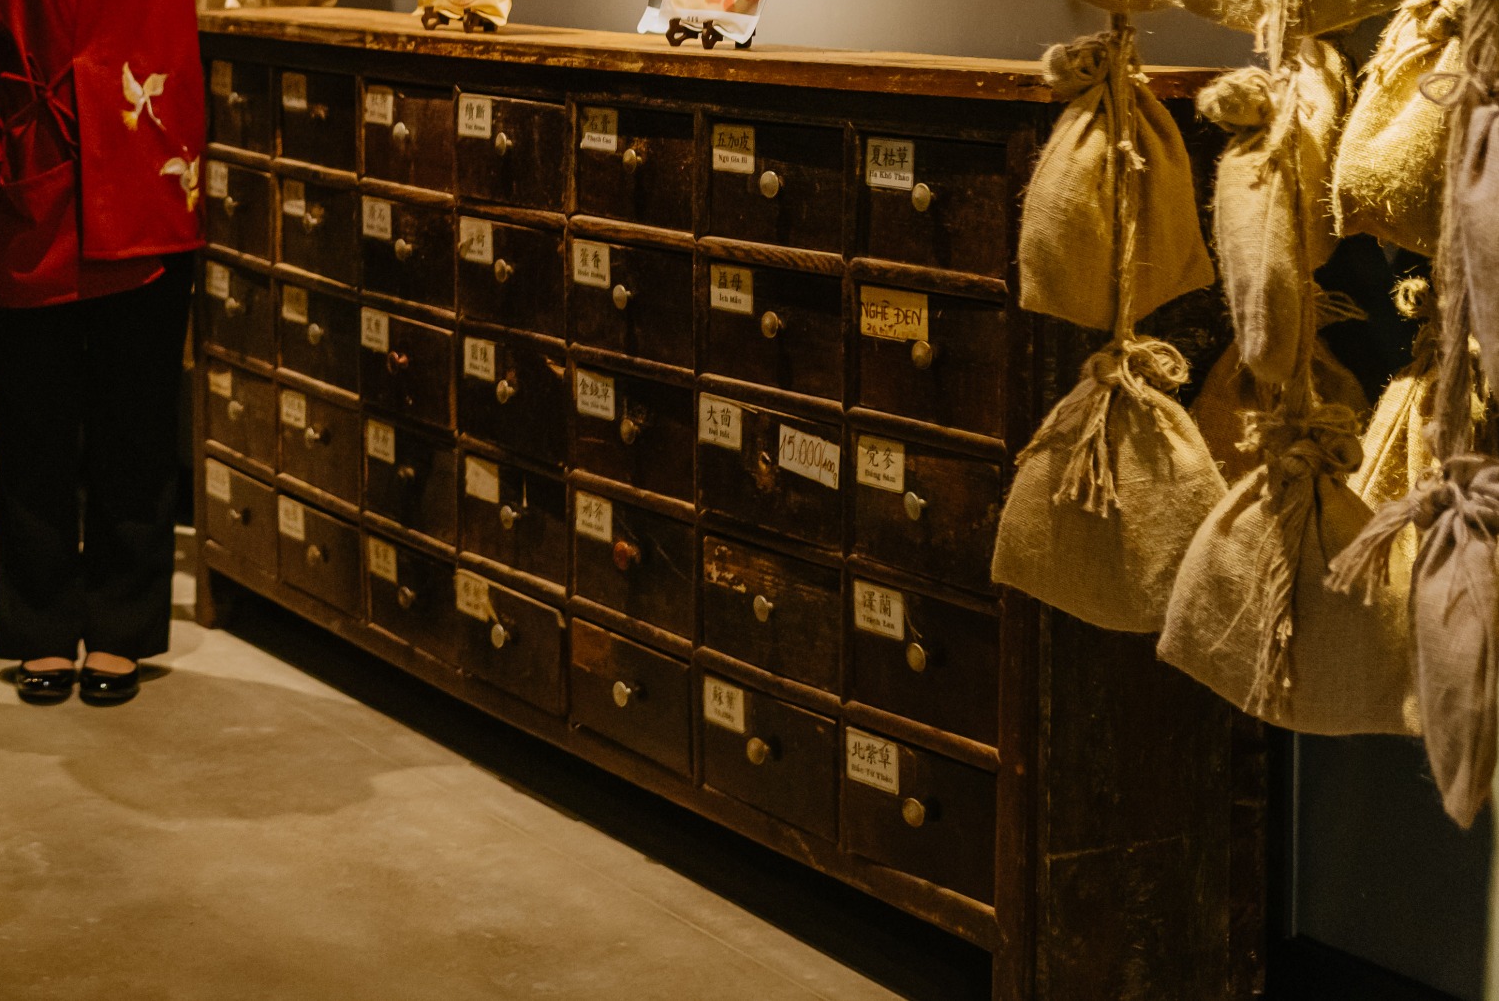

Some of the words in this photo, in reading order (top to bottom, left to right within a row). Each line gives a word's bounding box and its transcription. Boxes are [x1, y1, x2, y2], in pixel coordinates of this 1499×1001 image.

[716, 131, 750, 152] 五加皮
[870, 145, 909, 169] 夏枯草
[718, 271, 743, 292] 益母
[894, 307, 922, 326] ĐEN
[706, 405, 731, 427] 大茴
[852, 742, 891, 769] 北紫草
